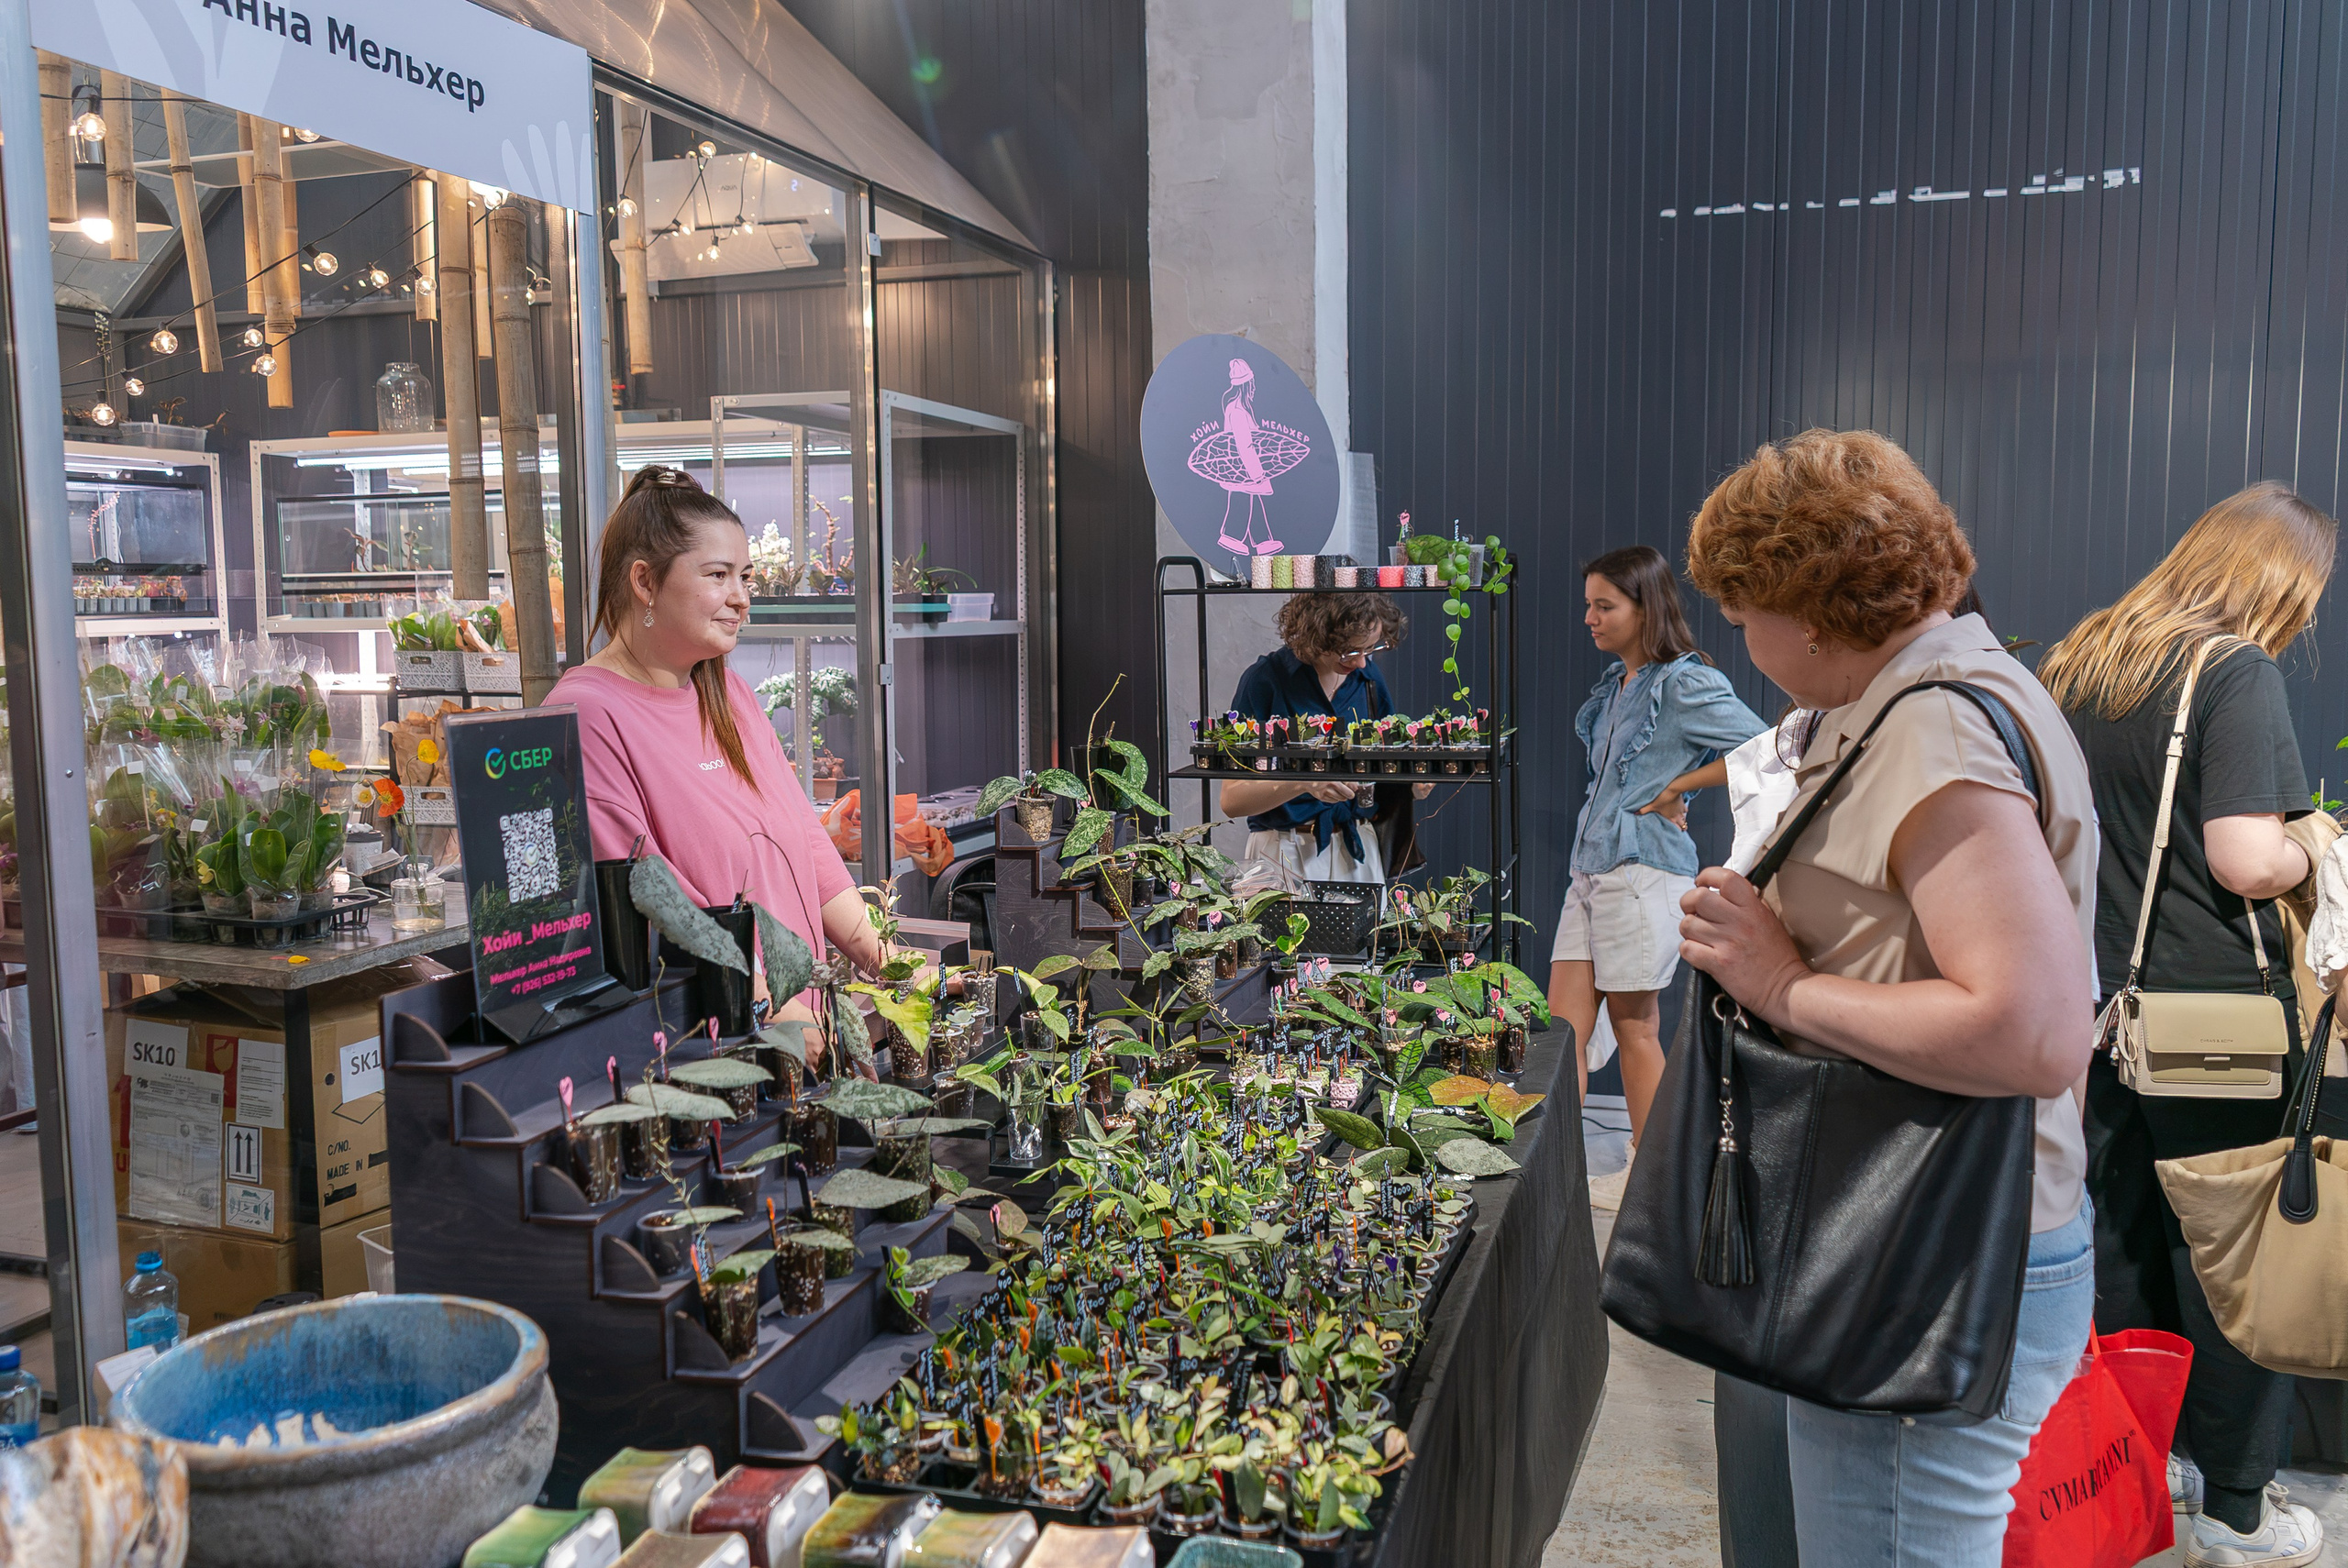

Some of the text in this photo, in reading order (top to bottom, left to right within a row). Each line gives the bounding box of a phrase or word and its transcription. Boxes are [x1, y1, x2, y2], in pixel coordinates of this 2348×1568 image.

[327, 16, 485, 114] Мельхер
[1190, 418, 1311, 444] ХОЙИ МЕЛЬХЕР
[510, 747, 552, 770] СБЕР
[482, 929, 523, 956] Хойи
[1354, 1028, 1365, 1036] 500
[133, 1042, 175, 1066] SK10
[327, 1139, 351, 1156] C/NO.
[327, 1159, 363, 1181] MADE IN
[1392, 1185, 1412, 1197] 1.000
[1066, 1208, 1082, 1220] 600
